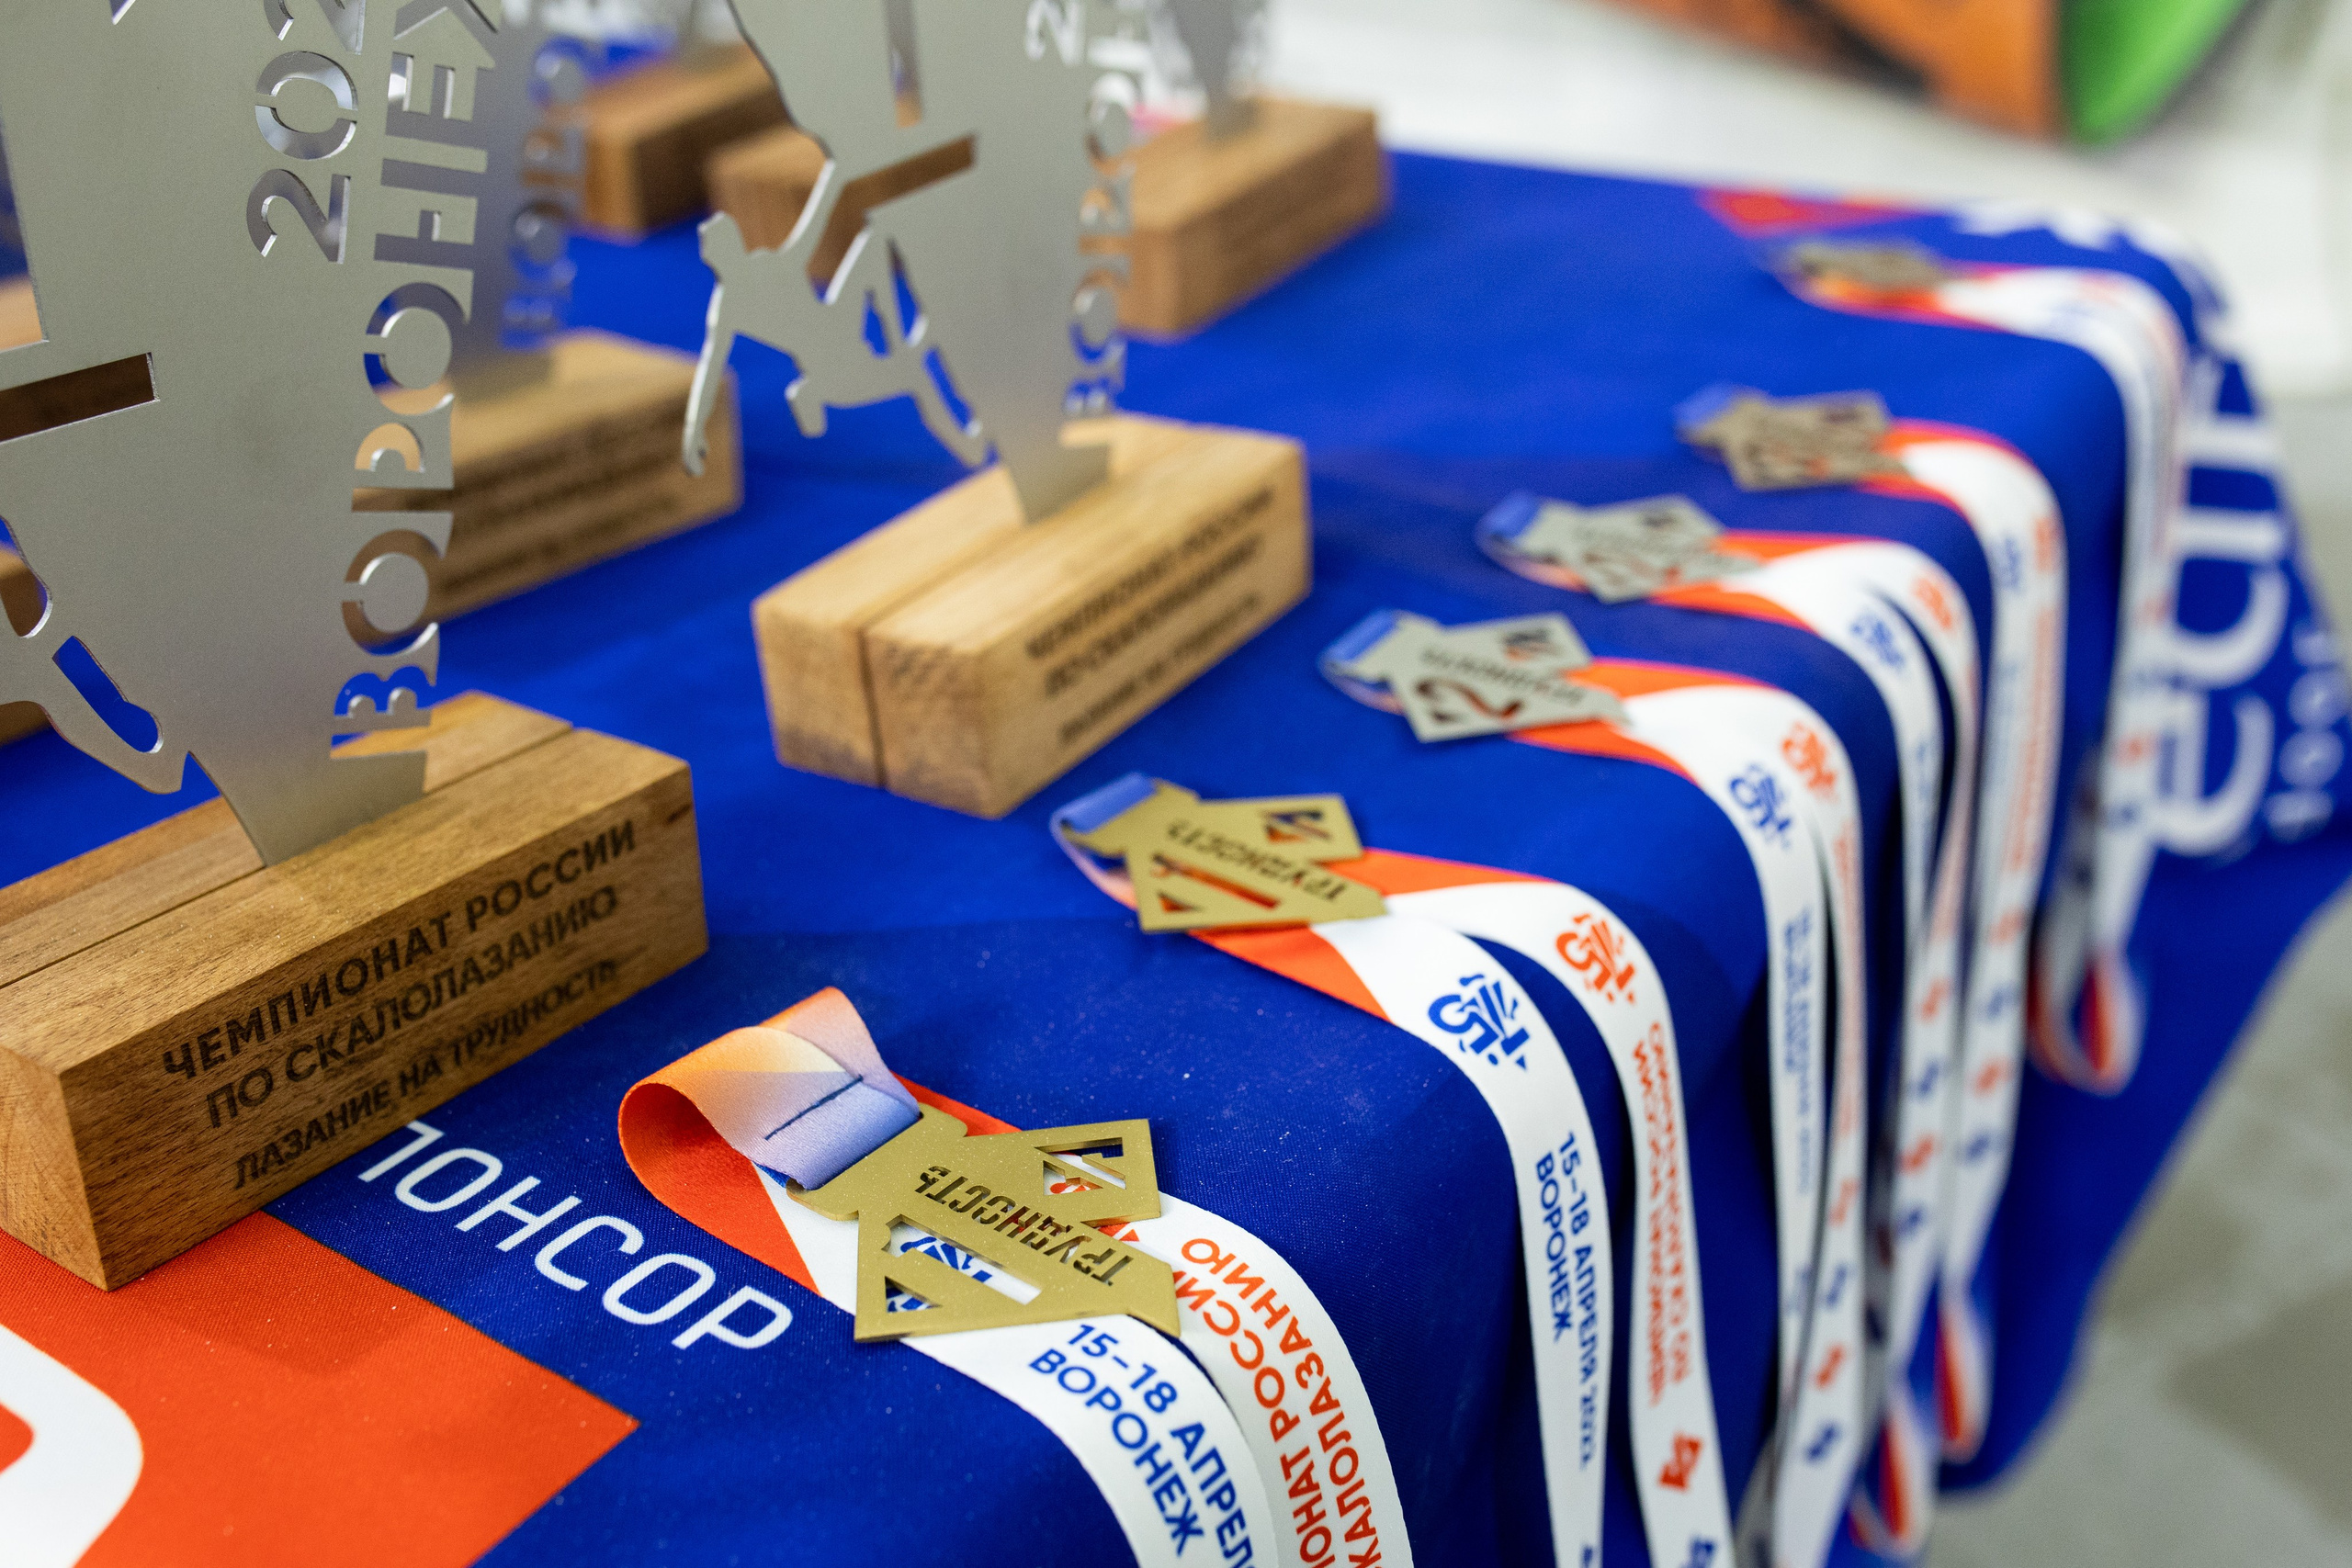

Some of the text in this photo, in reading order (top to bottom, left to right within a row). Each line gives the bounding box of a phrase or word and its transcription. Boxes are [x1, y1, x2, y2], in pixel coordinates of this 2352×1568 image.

[163, 819, 637, 1080] ЧЕМПИОНАТ РОССИИ
[206, 884, 618, 1129] ПО СКАЛОЛАЗАНИЮ
[235, 957, 619, 1189] ЛАЗАНИЕ НА ТРУДНОСТЬ
[914, 1165, 1135, 1287] ТРУДНОСТЬ
[1535, 1150, 1575, 1344] ВОРОНЕЖ
[1559, 1131, 1590, 1236] 15-18
[1068, 1324, 1178, 1414] 15-18
[1170, 1269, 1301, 1443] РОССИ
[1574, 1243, 1599, 1385] АПРЕЛЯ
[1028, 1348, 1205, 1558] ВОРОНЕЖ
